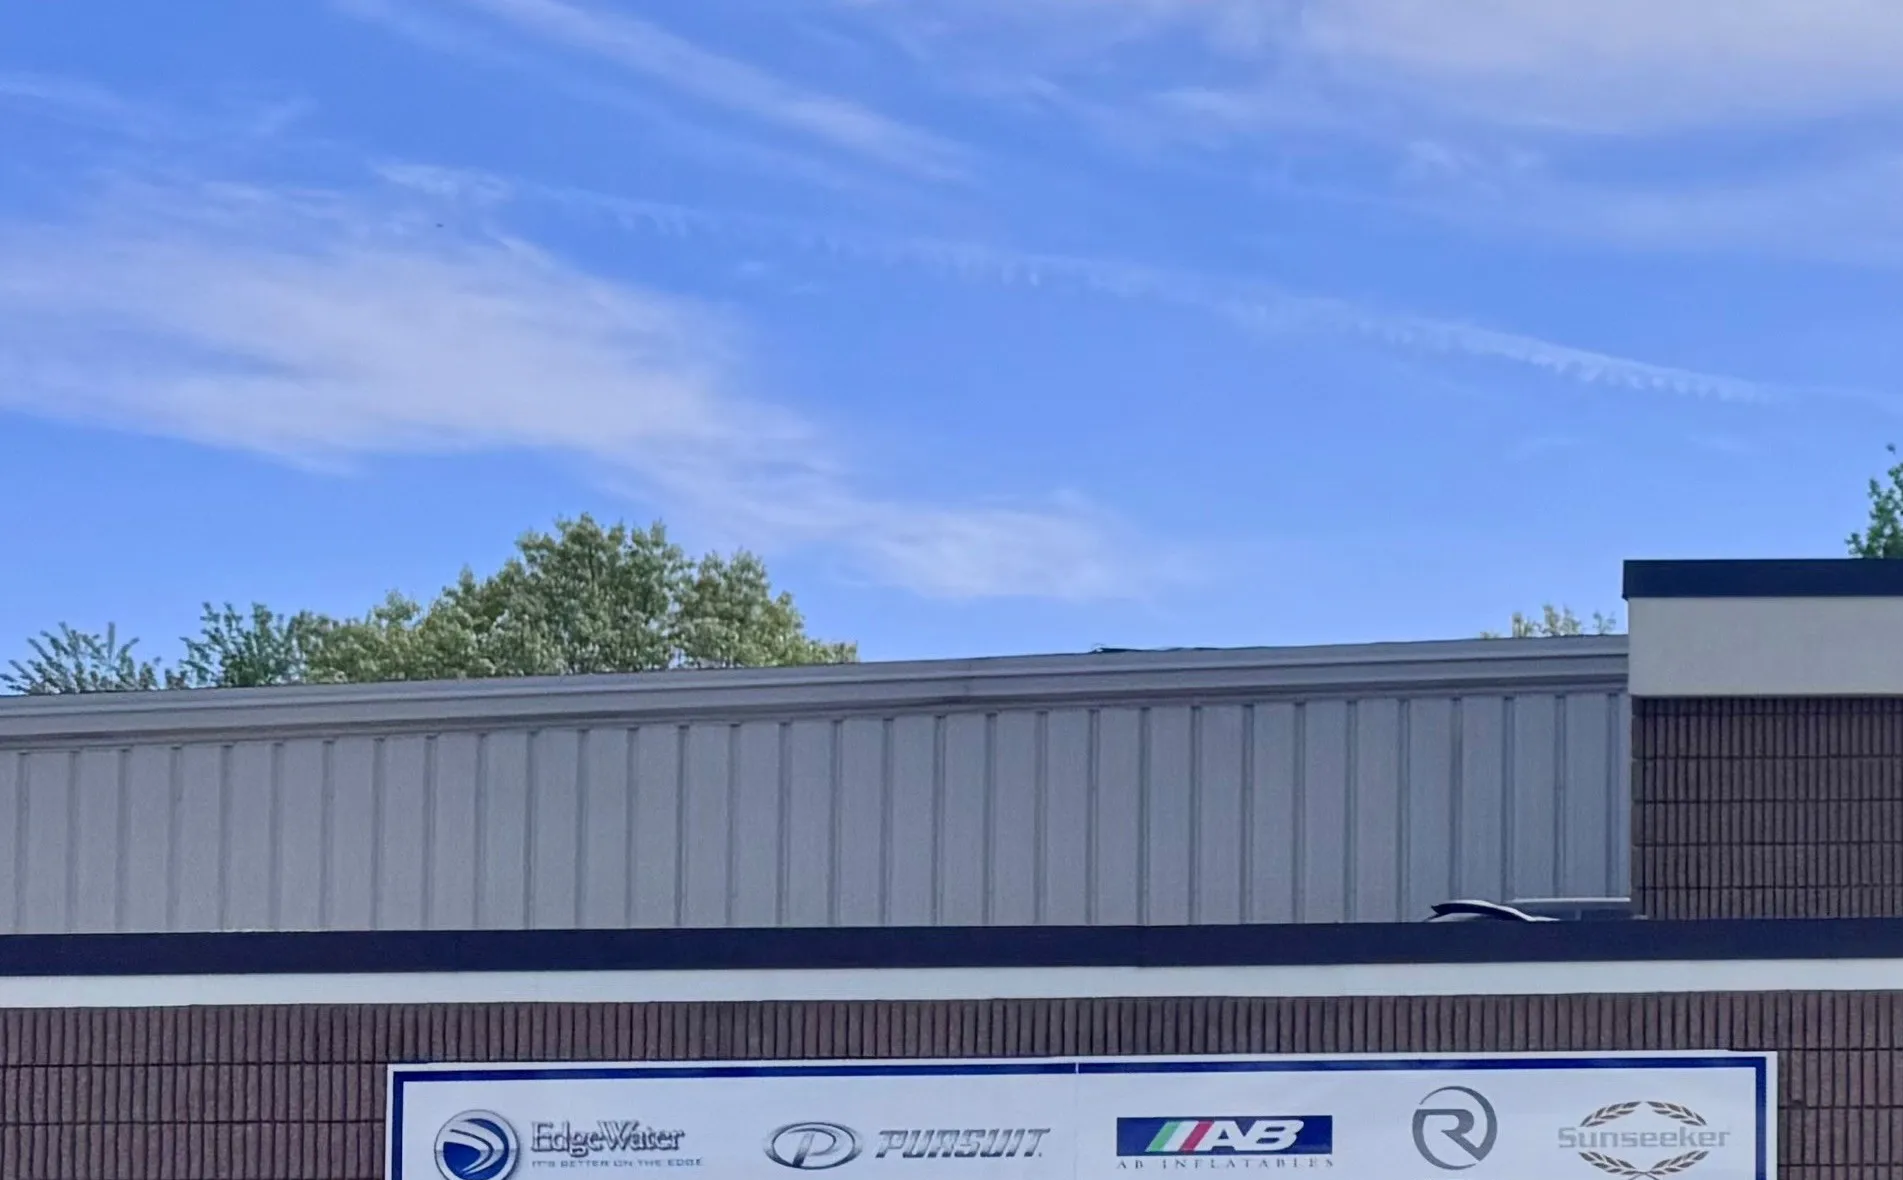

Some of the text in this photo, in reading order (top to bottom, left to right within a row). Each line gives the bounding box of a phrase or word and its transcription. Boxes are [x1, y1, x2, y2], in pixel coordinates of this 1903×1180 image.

[530, 1120, 685, 1158] EdgeWater
[1194, 1119, 1305, 1152] AB
[1557, 1126, 1731, 1149] Sunseeker
[560, 1159, 609, 1168] BETTER
[613, 1159, 633, 1168] ON
[637, 1158, 662, 1167] THE
[667, 1157, 703, 1167] EDGE
[1116, 1157, 1334, 1170] AB INFLATABLES
